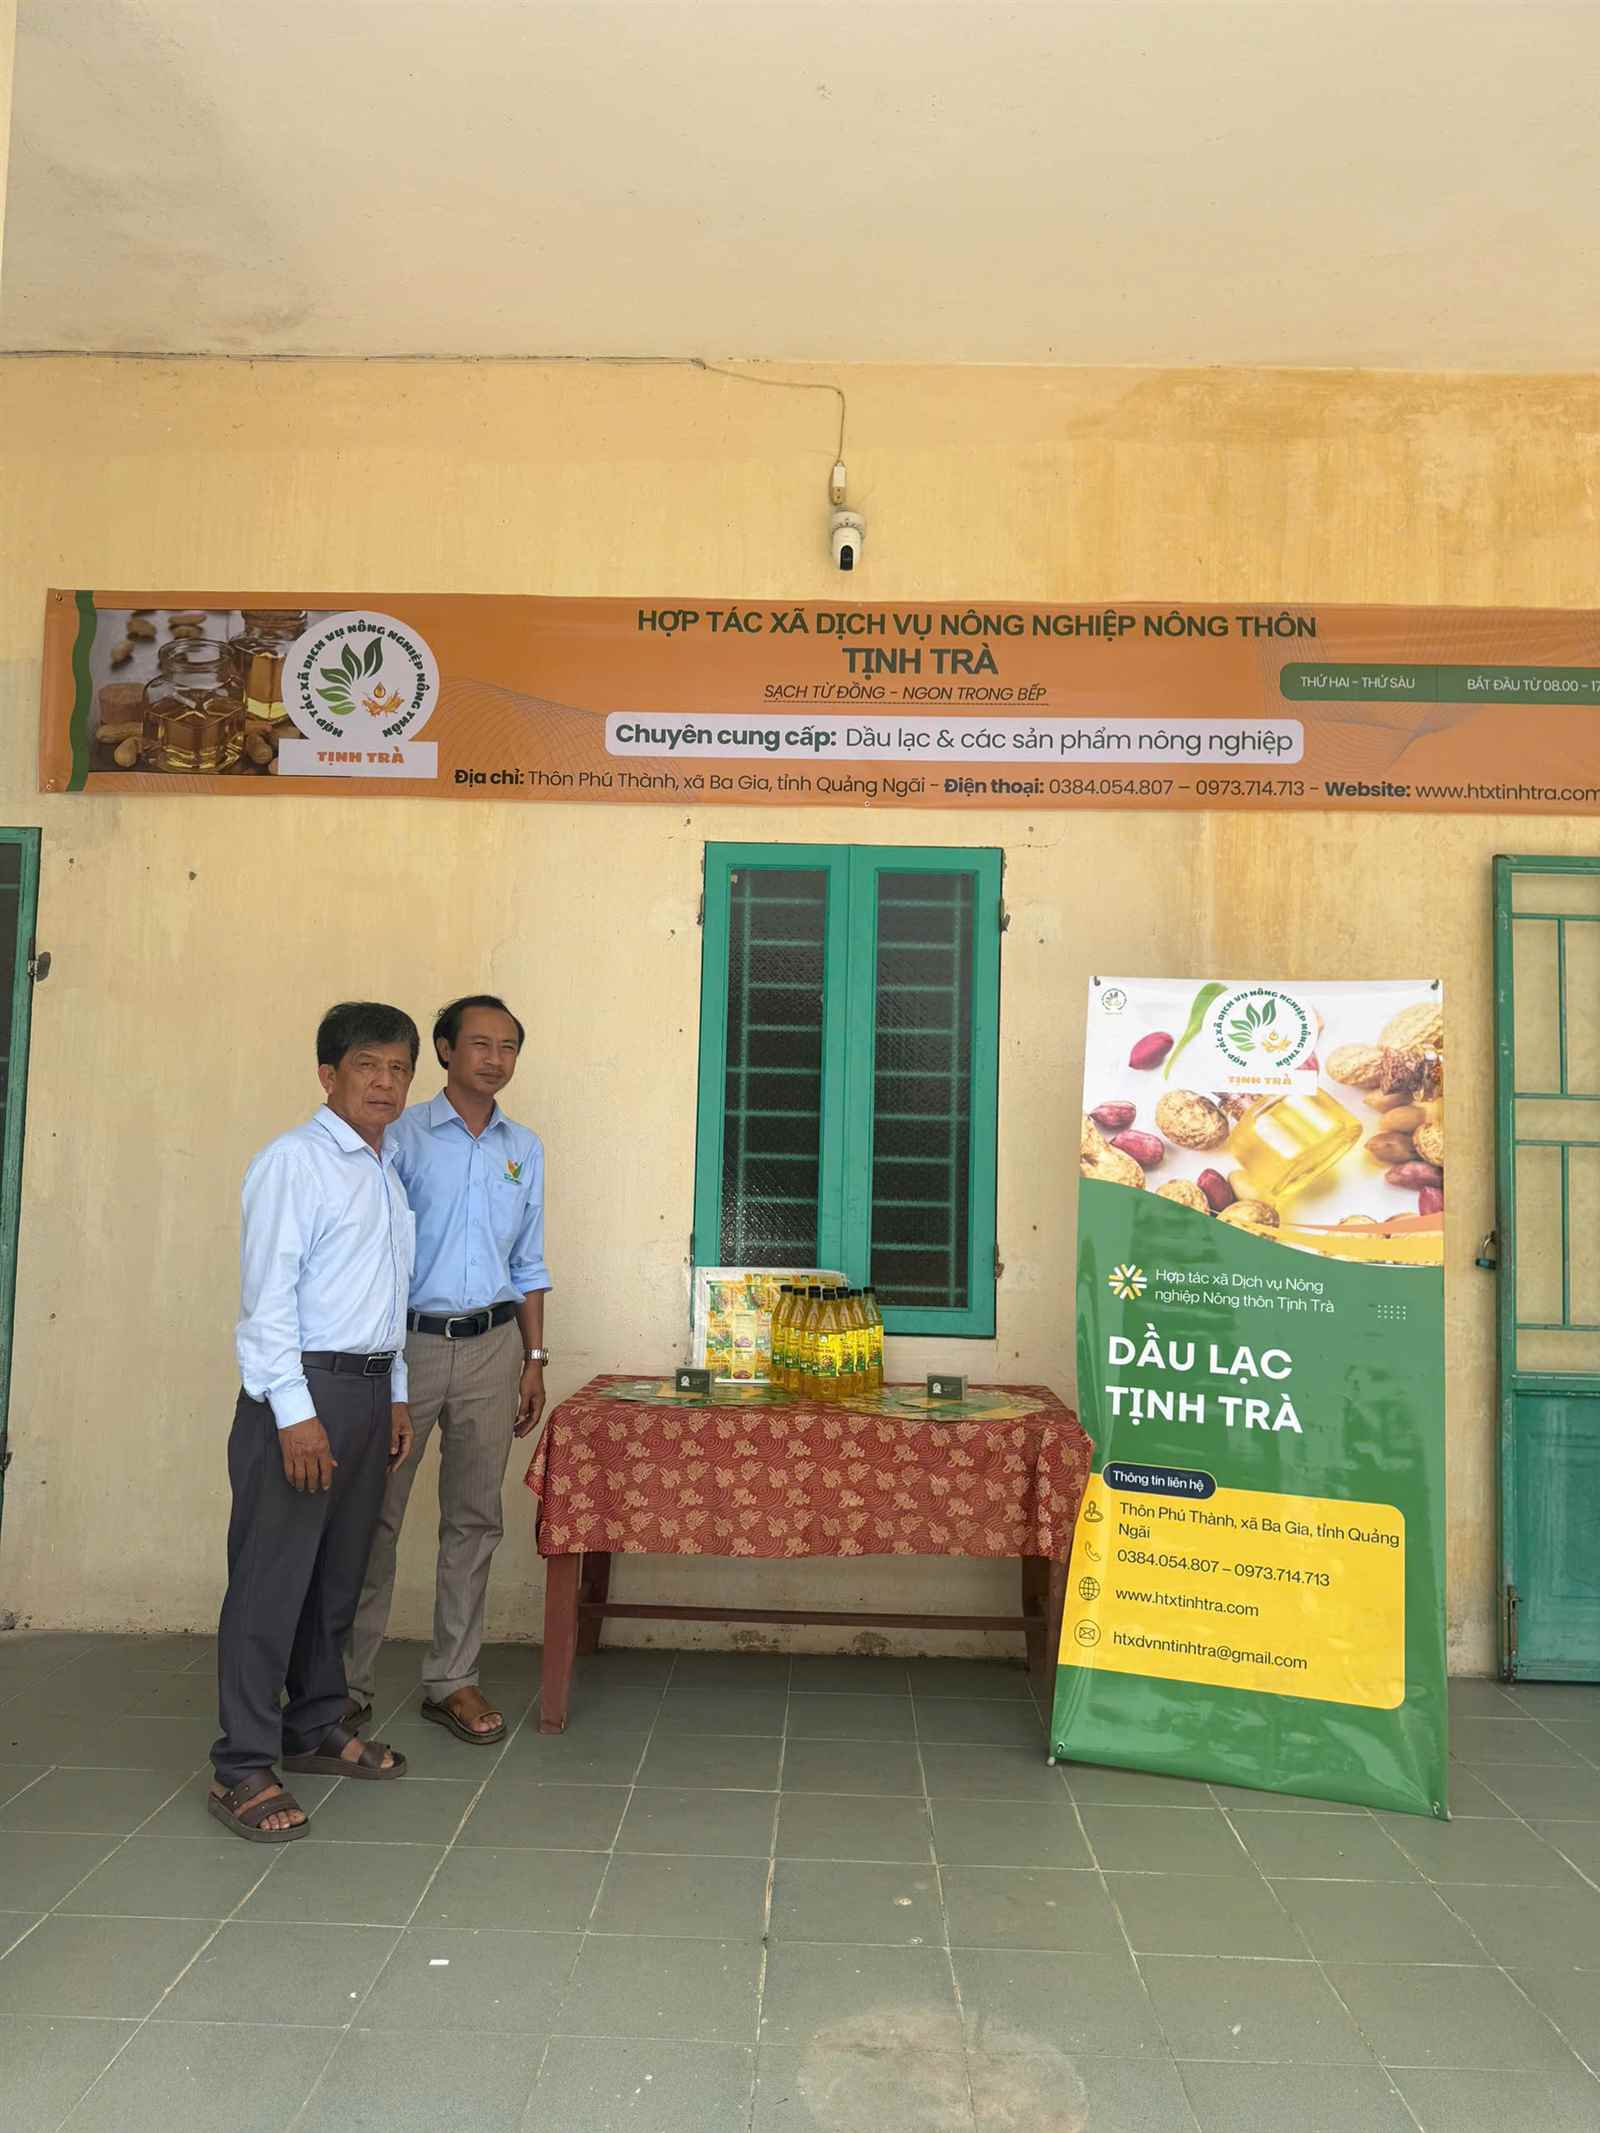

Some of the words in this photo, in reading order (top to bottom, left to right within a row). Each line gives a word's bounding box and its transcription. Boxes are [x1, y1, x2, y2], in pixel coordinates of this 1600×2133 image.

[325, 628, 345, 642] VỤ
[347, 619, 385, 636] NÔNG
[638, 609, 699, 637] HỢP
[706, 607, 762, 633] TÁC
[769, 608, 809, 634] XÃ
[816, 612, 885, 639] DỊCH
[893, 614, 932, 640] VỤ
[941, 609, 1024, 637] NÔNG
[1032, 609, 1136, 641] NGHIỆP
[1144, 610, 1229, 637] NÔNG
[1236, 612, 1316, 637] THÔN
[303, 639, 326, 670] DỊCH
[387, 630, 424, 671] NGHIỆP
[842, 647, 921, 680] TỊNH
[930, 643, 999, 674] TRÀ
[297, 671, 310, 691] XÃ
[411, 672, 430, 710] NÔNG
[764, 684, 808, 700] SẠCH
[813, 682, 835, 698] TỪ
[837, 681, 885, 699] ĐỒNG
[902, 686, 952, 700] NGON
[958, 687, 1013, 701] TRONG
[1018, 683, 1047, 701] BẾP
[1300, 673, 1327, 688] THỨ
[1329, 676, 1350, 688] HAI
[1523, 676, 1541, 692] TỪ
[1543, 680, 1579, 692] 08.00
[300, 693, 318, 718] TÁC
[316, 718, 343, 738] HỢP
[382, 712, 416, 738] THÔN
[616, 723, 712, 750] Chuyên
[716, 729, 780, 751] cung
[785, 725, 837, 752] cấp:
[846, 724, 890, 748] Dầu
[899, 728, 930, 751] lạc
[937, 730, 954, 748] &
[961, 729, 1006, 749] các
[1012, 727, 1052, 749] sản
[1061, 727, 1131, 755] phẩm
[1138, 731, 1200, 756] nông
[1208, 731, 1293, 757] nghiệp
[317, 751, 362, 766] TỊNH
[367, 746, 404, 764] TRÀ
[454, 769, 486, 788] Địa
[490, 768, 524, 785] chỉ:
[528, 770, 573, 787] Thôn
[579, 772, 613, 787] Phú
[617, 773, 679, 791] Thành,
[683, 775, 704, 789] xã
[710, 775, 732, 790] Ba
[738, 775, 772, 793] Gia,
[777, 774, 811, 791] tỉnh
[816, 774, 877, 797] Quảng
[883, 777, 925, 797] Ngãi
[944, 778, 987, 797] Điện
[991, 778, 1044, 798] thoại:
[1049, 779, 1173, 795] 0384.054.807
[1196, 780, 1304, 796] 0973.714.713
[1325, 781, 1410, 798] Website:
[1416, 783, 1600, 801] www.htxtinhtra.com
[1155, 1268, 1185, 1285] Hợp
[1188, 1271, 1209, 1284] tác
[1212, 1273, 1229, 1286] xã
[1232, 1273, 1262, 1289] Dịch
[1266, 1279, 1282, 1292] vụ
[1286, 1278, 1323, 1295] Nông
[1155, 1289, 1200, 1305] nghiệp
[1203, 1291, 1240, 1309] Nông
[1243, 1295, 1273, 1309] thôn
[1277, 1296, 1307, 1312] Tịnh
[1310, 1299, 1335, 1313] Trà
[1108, 1322, 1195, 1372] DẦU
[1209, 1343, 1293, 1385] LẠC
[1105, 1385, 1205, 1426] TỊNH
[1218, 1393, 1303, 1434] TRÀ
[1112, 1470, 1149, 1487] Thông
[1151, 1474, 1165, 1487] tin
[1167, 1475, 1187, 1489] liên
[1189, 1478, 1204, 1492] hệ
[1119, 1501, 1155, 1518] Thôn
[1158, 1506, 1186, 1521] Phú
[1189, 1510, 1237, 1529] Thành,
[1240, 1516, 1258, 1530] xã
[1262, 1518, 1281, 1533] Ba
[1284, 1520, 1313, 1538] Gia,
[1317, 1523, 1344, 1540] tỉnh
[1348, 1527, 1399, 1548] Quảng
[1119, 1523, 1150, 1540] Ngãi
[1117, 1549, 1219, 1574] 0384.054.807
[1234, 1563, 1330, 1587] 0973.714.713
[1115, 1588, 1259, 1617] www.htxtinhtra.com
[1113, 1631, 1308, 1670] htxdvnntinhtra@gmail.com
